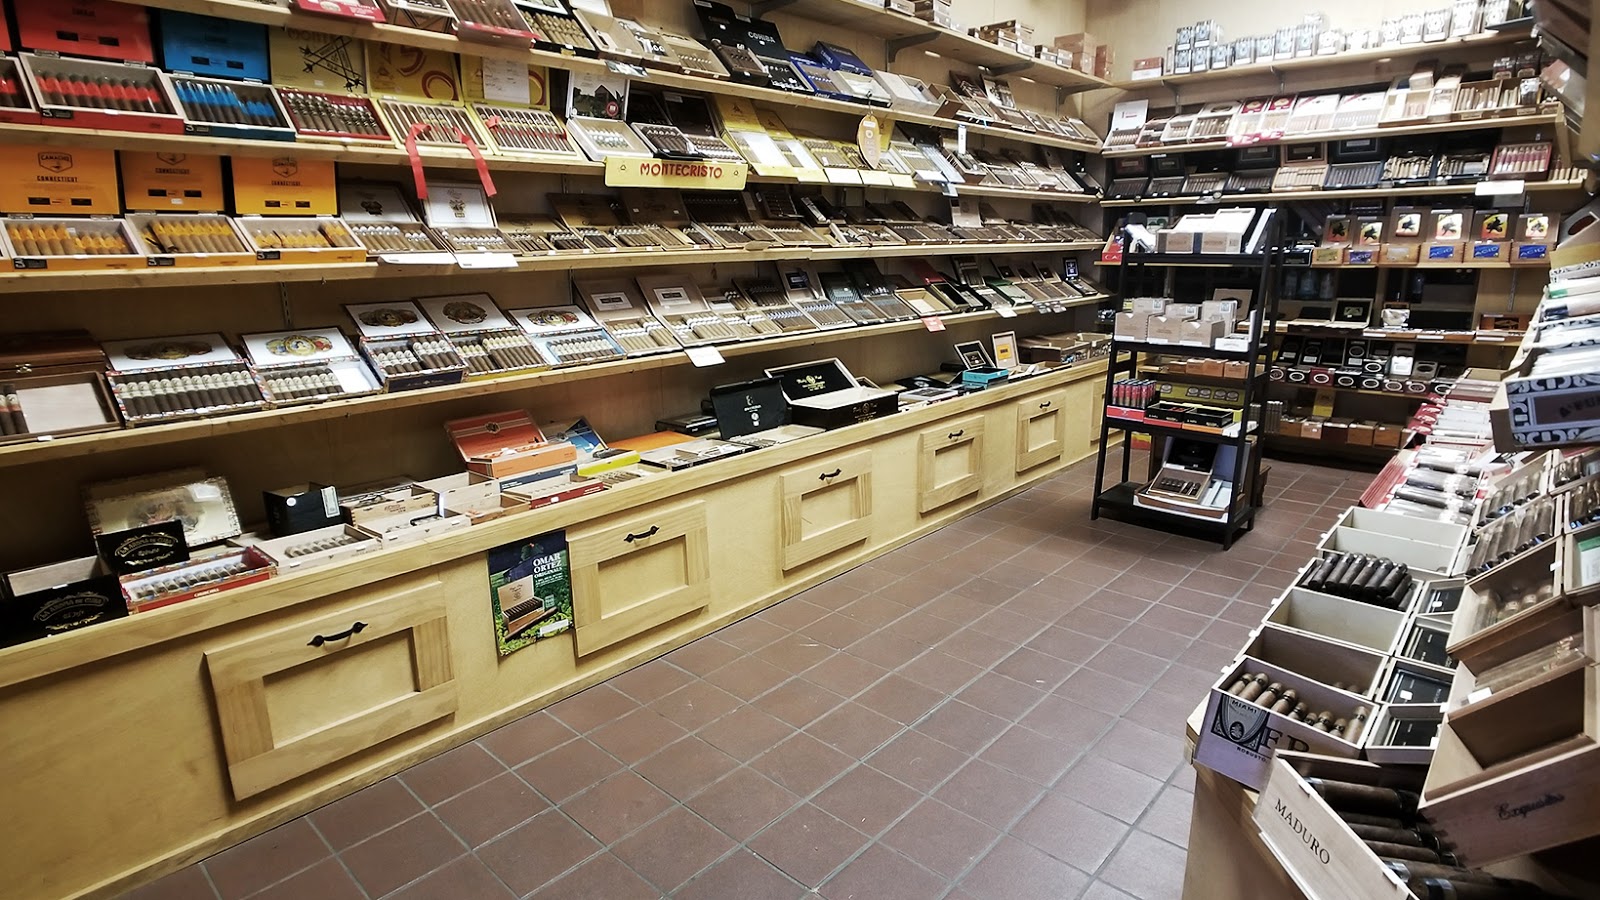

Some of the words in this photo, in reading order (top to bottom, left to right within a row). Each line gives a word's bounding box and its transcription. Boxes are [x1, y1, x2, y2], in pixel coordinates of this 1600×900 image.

[640, 163, 723, 178] MONTECRISTO
[1351, 253, 1371, 262] ACID
[1430, 248, 1453, 257] ACID
[1474, 246, 1498, 256] ACID
[1520, 246, 1545, 257] ACID
[533, 553, 561, 567] OMAR
[533, 560, 562, 574] ORTEZ
[1231, 700, 1257, 714] MIAMI
[1236, 747, 1267, 761] ROBUSTO
[1275, 799, 1330, 864] MADURO
